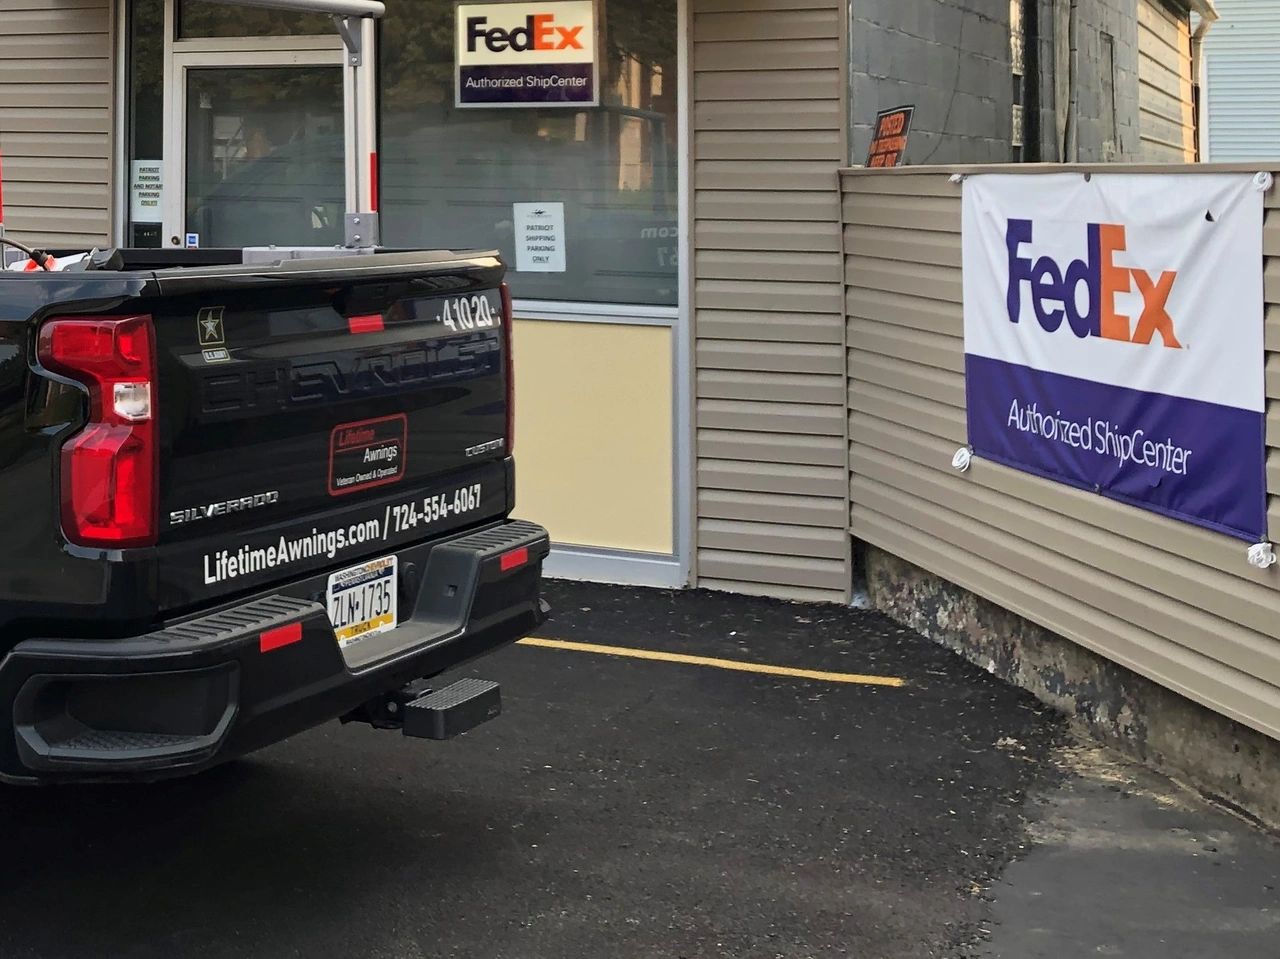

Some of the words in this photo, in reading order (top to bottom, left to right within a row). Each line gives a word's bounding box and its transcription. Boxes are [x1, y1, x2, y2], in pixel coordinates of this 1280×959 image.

[467, 14, 584, 52] FedEx
[465, 76, 523, 88] Authorized
[526, 75, 587, 89] ShipCenter
[1006, 218, 1183, 349] FedEx
[338, 428, 375, 447] Lifetime
[363, 444, 398, 463] Awnings
[1007, 398, 1092, 450] Authorized
[1094, 420, 1192, 475] ShipCenter
[336, 474, 355, 487] Veteran
[355, 471, 372, 484] Owned
[377, 465, 398, 480] Operated
[170, 490, 280, 525] SILVERADO
[203, 520, 380, 585] LifetimeAwnings.com
[382, 505, 391, 540] /
[393, 483, 481, 532] 724-554-6067
